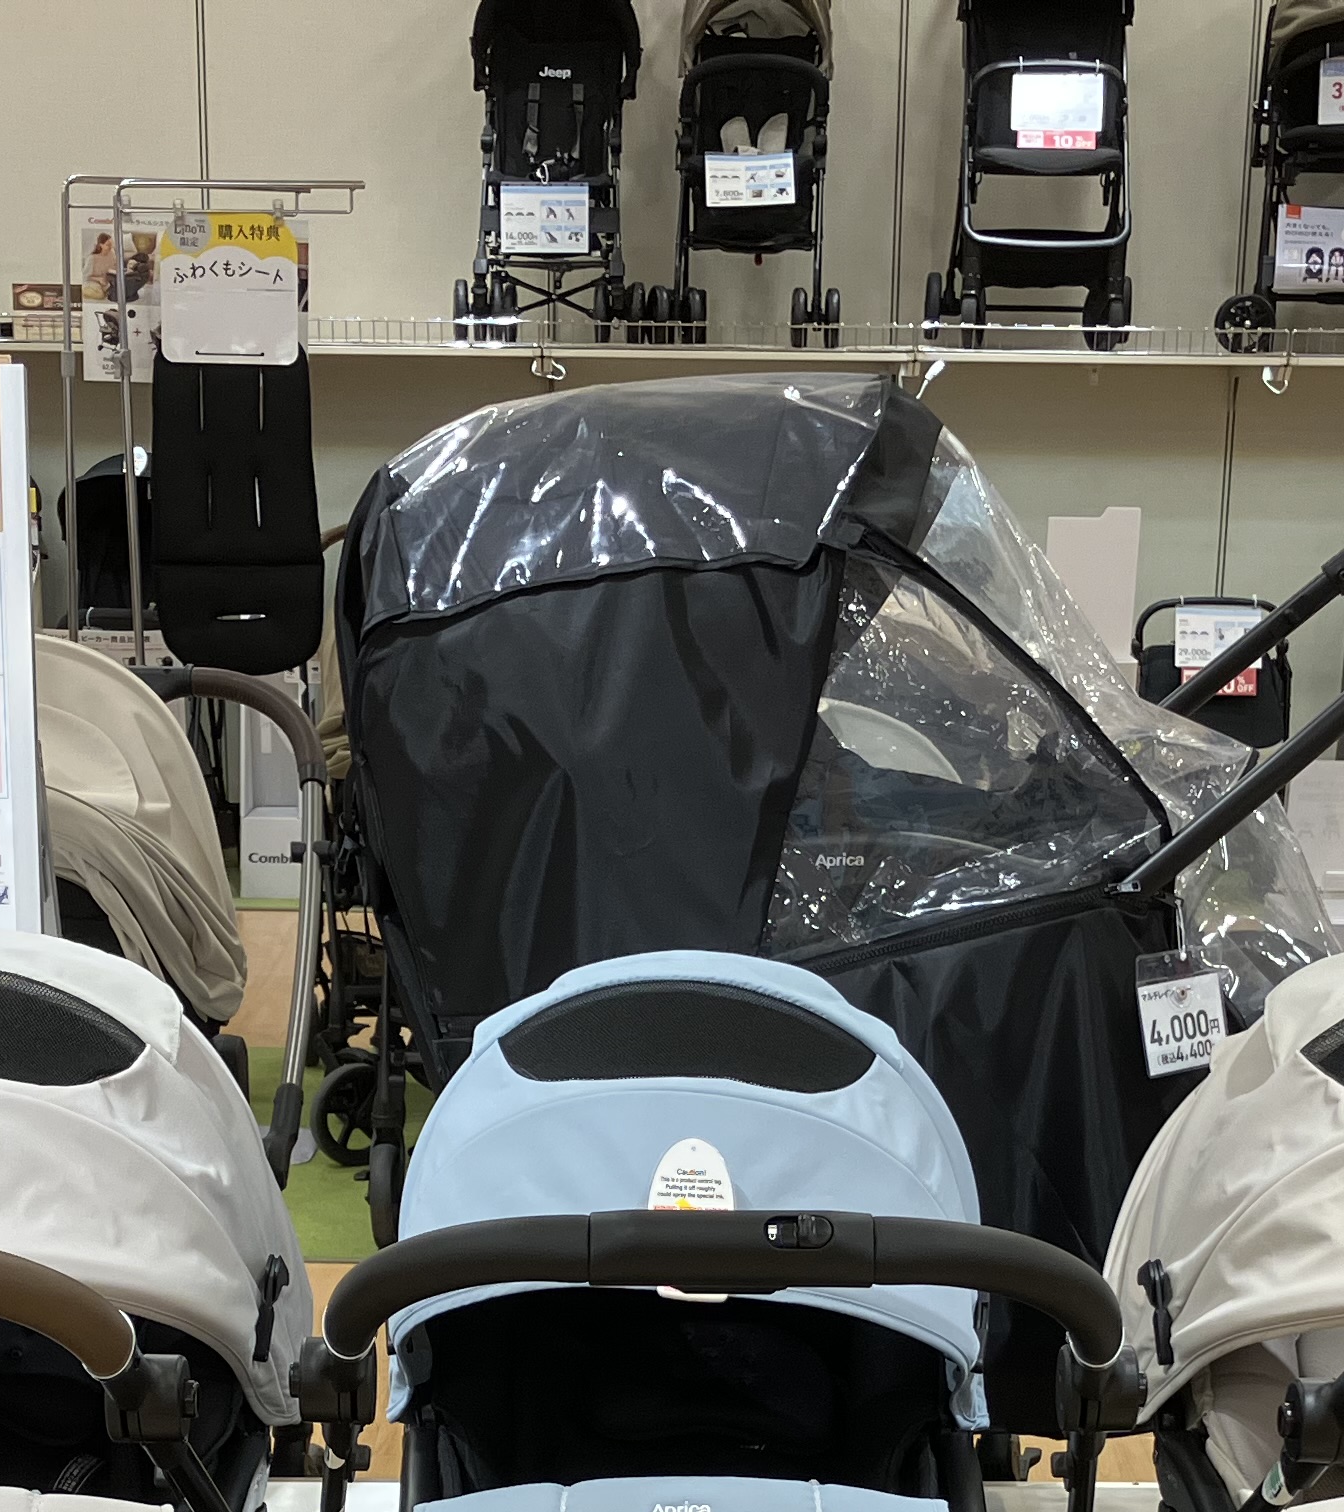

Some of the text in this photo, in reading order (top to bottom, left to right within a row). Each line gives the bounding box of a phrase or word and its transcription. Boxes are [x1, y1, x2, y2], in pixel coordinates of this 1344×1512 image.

[539, 66, 571, 79] Jeep
[218, 224, 281, 241] 購入特典
[174, 260, 284, 283] ふわくもシート
[1150, 1010, 1221, 1046] 4,000円
